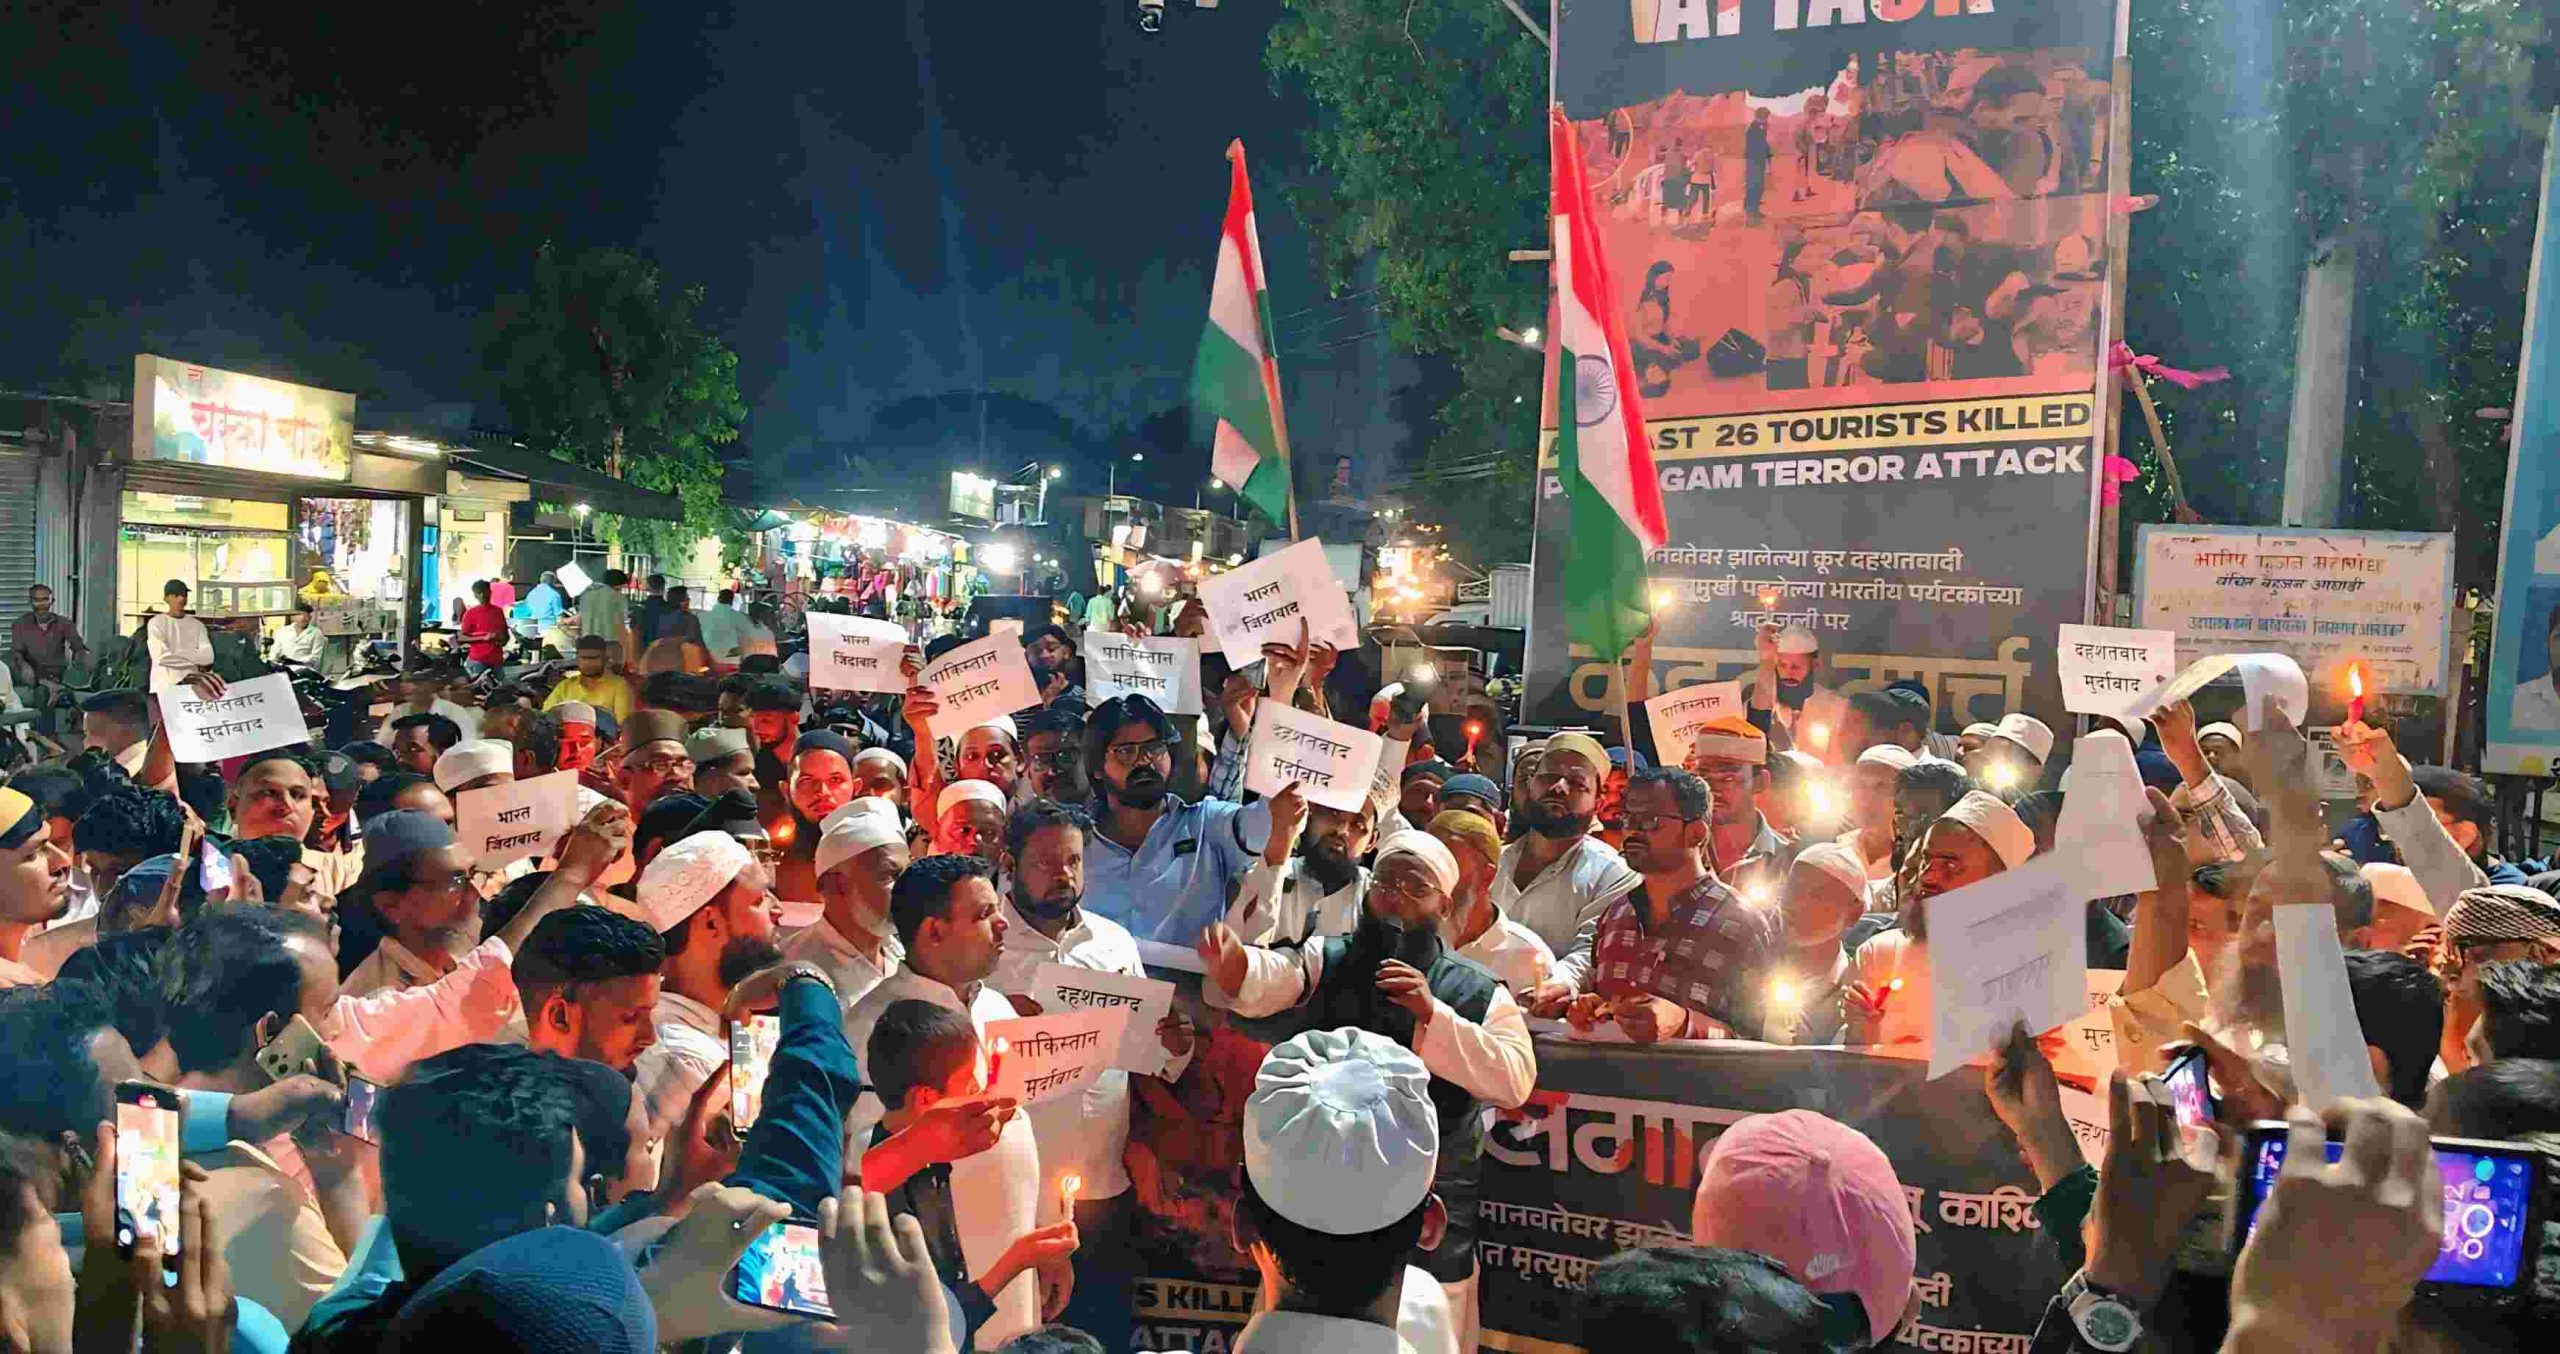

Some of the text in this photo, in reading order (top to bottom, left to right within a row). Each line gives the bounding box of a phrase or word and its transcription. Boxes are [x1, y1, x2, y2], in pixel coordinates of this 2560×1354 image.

[1715, 422, 1759, 448] 26
[1767, 410, 1948, 444] TOURISTS
[1956, 402, 2091, 433] KILLED
[1751, 454, 1905, 488] TERROR
[1913, 445, 2086, 480] ATTACK
[1727, 543, 1808, 570] झालेल्या
[1813, 549, 1848, 575] क्रूर
[1850, 548, 1964, 572] दहशतवादी
[1243, 581, 1281, 602] भारत
[1830, 577, 1904, 601] भारतीय
[1908, 579, 2024, 605] पर्यटकांच्या
[1823, 611, 1850, 631] पर
[841, 634, 870, 647] भारत
[2074, 643, 2148, 664] दहशतवाद
[929, 649, 999, 685] पाकिस्तान
[1102, 643, 1175, 666] पाकिस्तान
[180, 691, 265, 717] दहशतवाद
[497, 806, 531, 824] भारत
[1011, 1029, 1101, 1059] पाकिस्तान
[1478, 1199, 1610, 1241] मानवतेवर
